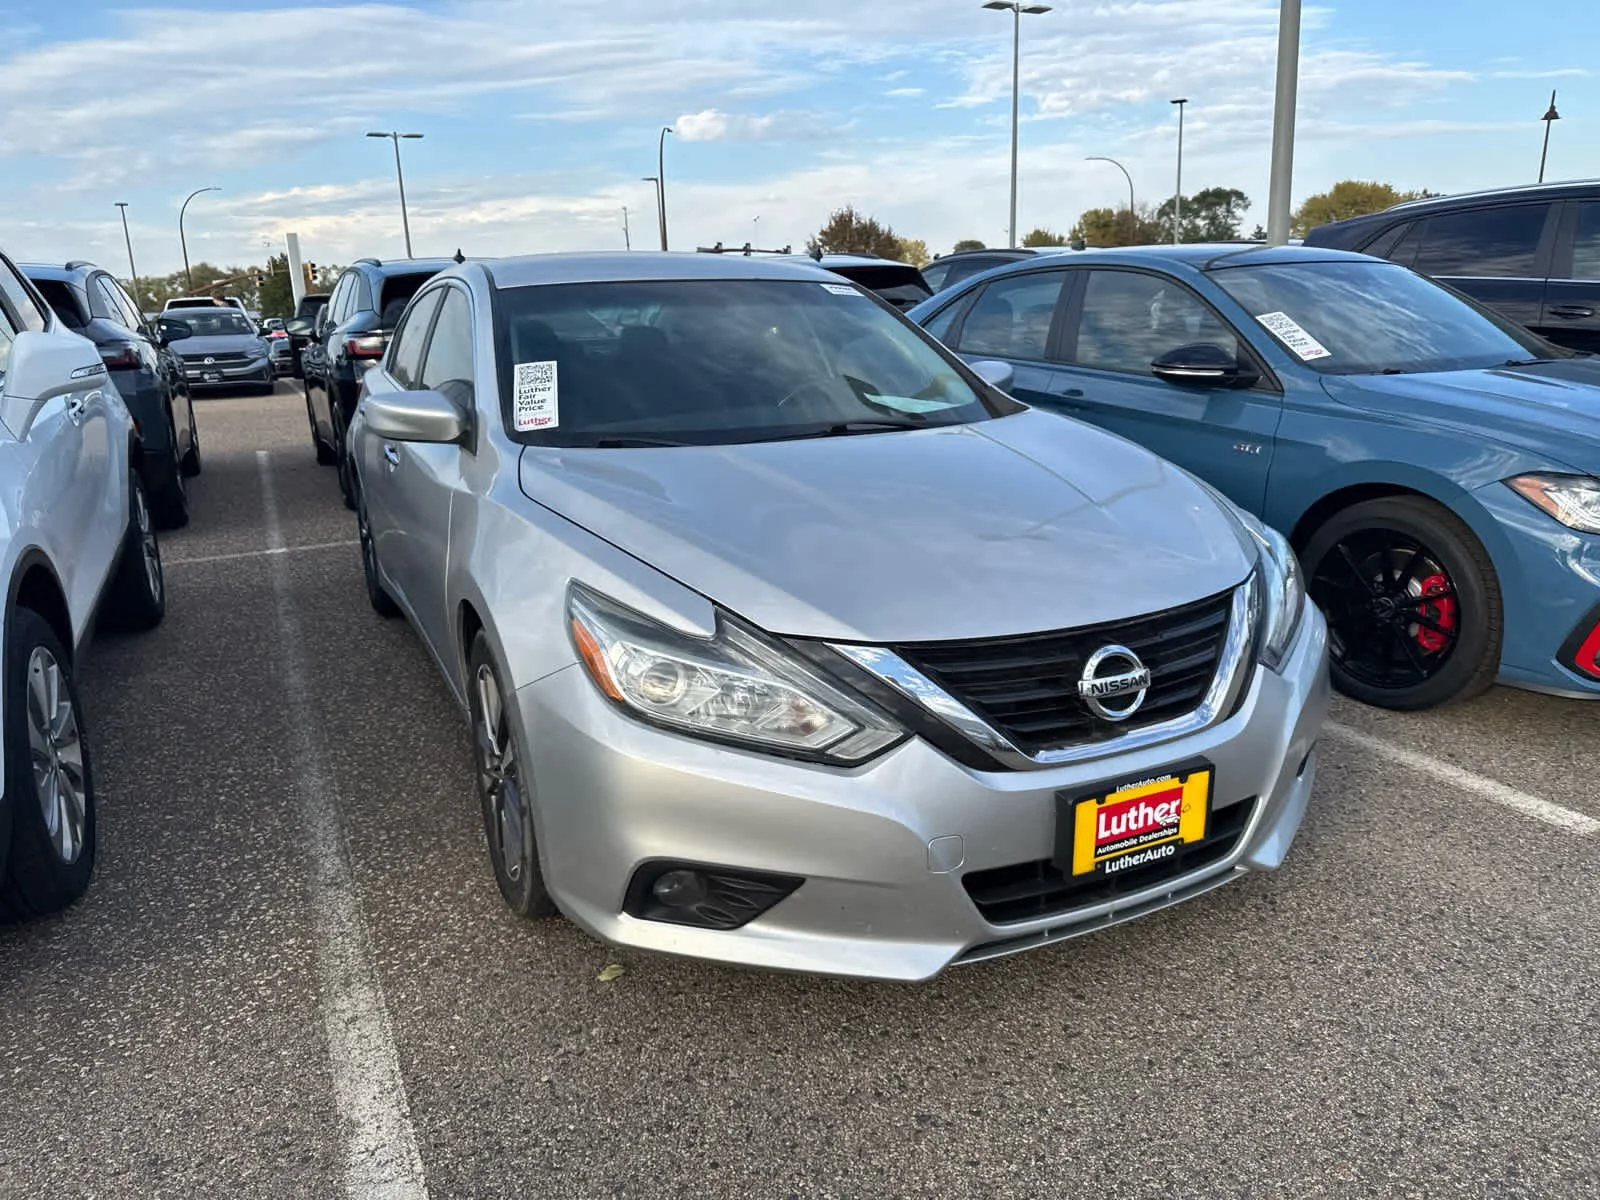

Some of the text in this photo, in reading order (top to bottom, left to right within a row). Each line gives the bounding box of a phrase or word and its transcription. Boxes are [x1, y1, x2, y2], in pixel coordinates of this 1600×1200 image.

[518, 393, 536, 401] Fair
[518, 398, 547, 406] Value
[518, 404, 544, 413] Price
[1091, 674, 1147, 694] NISSAN
[1116, 774, 1172, 793] LutherAuto.com
[1098, 798, 1181, 839] Luther
[1096, 826, 1178, 855] Automobile Dealerships
[1104, 844, 1175, 874] LutherAuto
